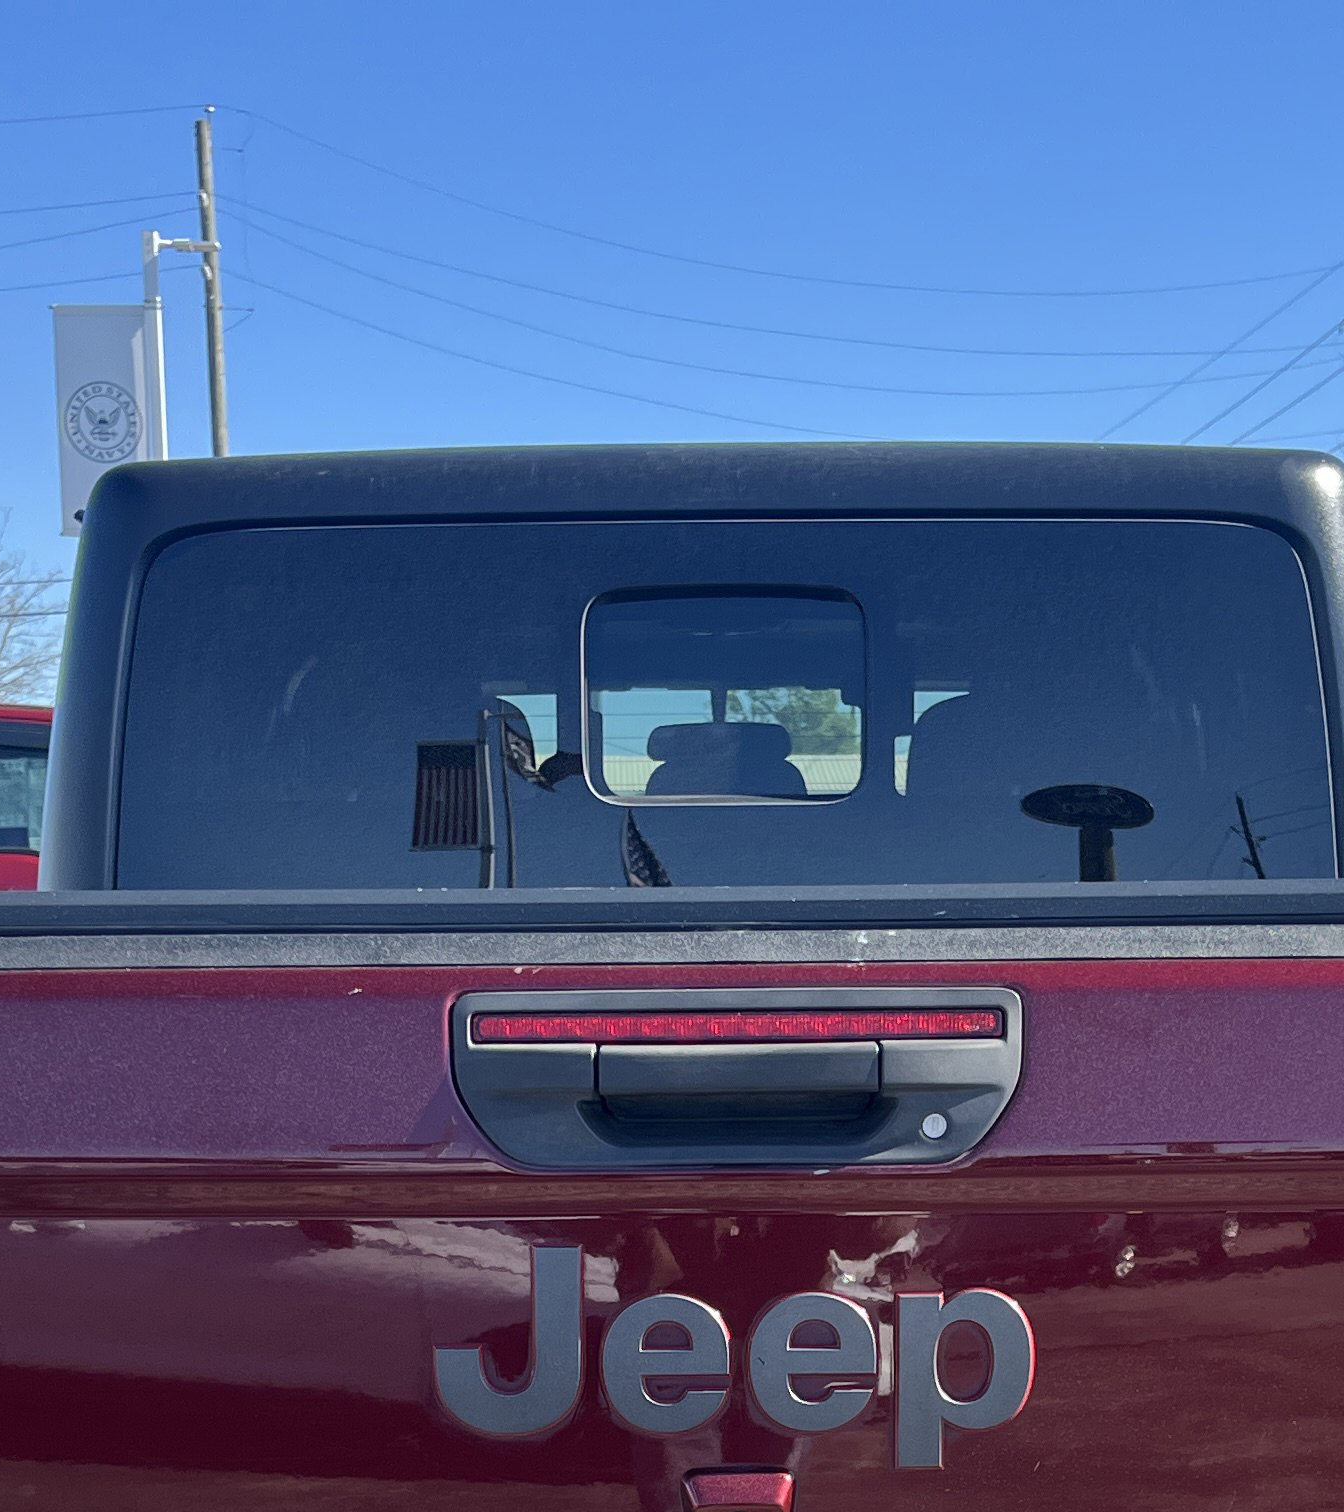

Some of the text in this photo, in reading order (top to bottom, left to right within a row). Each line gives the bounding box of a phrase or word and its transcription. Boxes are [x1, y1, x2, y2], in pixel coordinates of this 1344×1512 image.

[68, 384, 138, 439] UNITED STATES
[83, 443, 127, 460] NAVY
[433, 1244, 1036, 1470] Jeep
